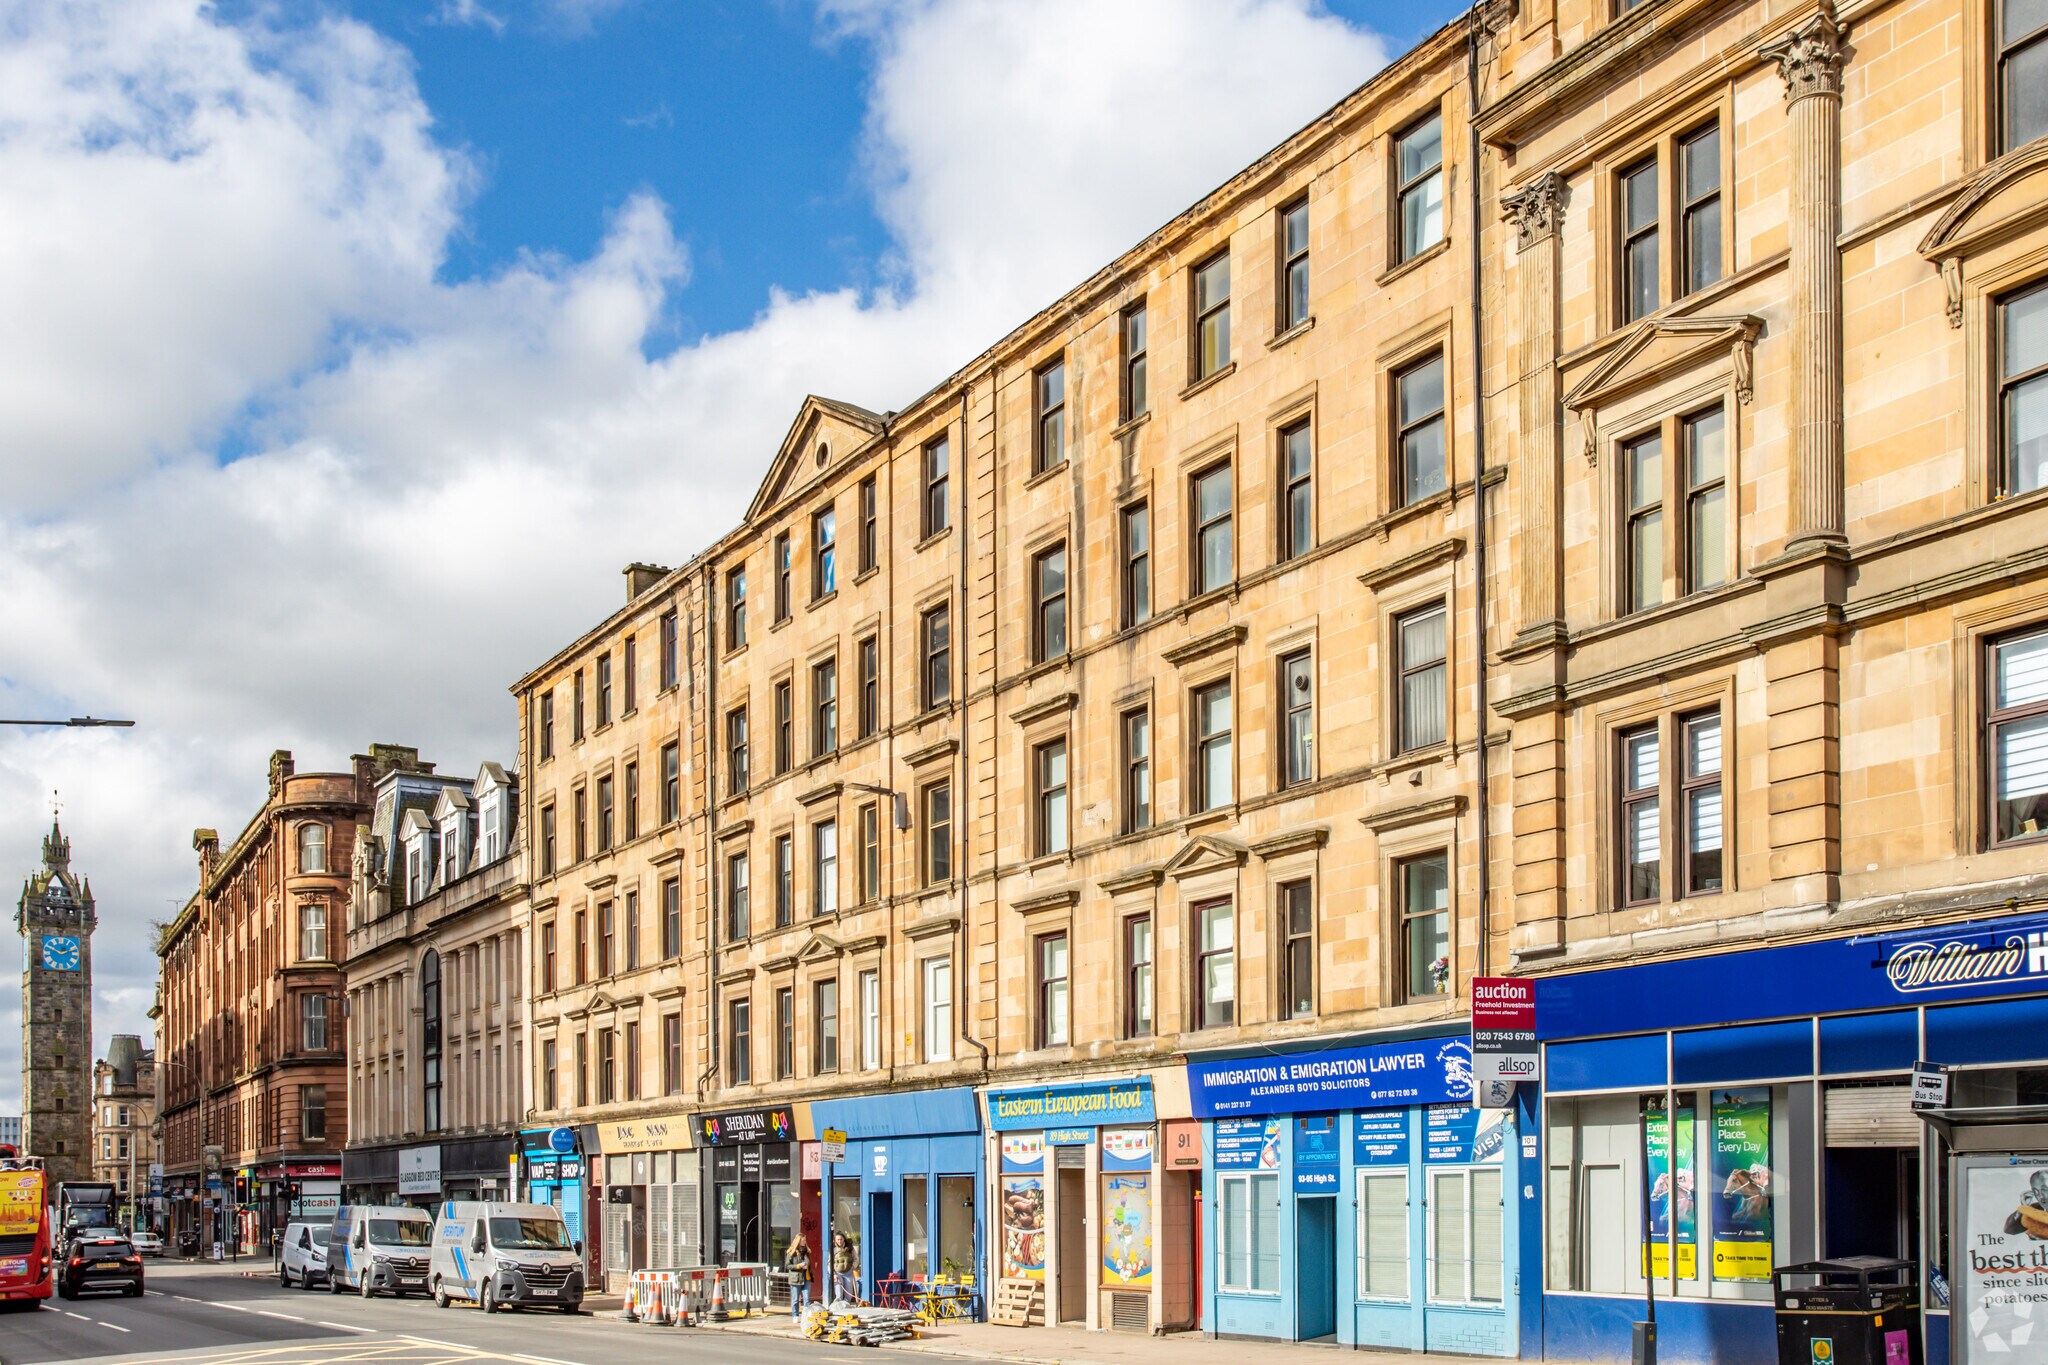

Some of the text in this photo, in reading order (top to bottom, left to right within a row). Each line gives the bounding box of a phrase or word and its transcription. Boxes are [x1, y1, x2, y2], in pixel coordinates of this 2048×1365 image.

[1887, 935, 2025, 988] William
[1475, 982, 1527, 999] auction
[1475, 1032, 1535, 1041] 020 7543 6780
[1203, 1053, 1425, 1087] IMMIGRATION & EMIGRATION LAWYER
[1498, 1057, 1535, 1075] allsop
[1250, 1078, 1370, 1096] ALEXANDER BOYD SOLICITORS
[1396, 1089, 1403, 1097] 72
[999, 1085, 1142, 1117] Eastern European Food
[1915, 1091, 1943, 1101] Bus Stop
[725, 1113, 765, 1131] SHERIDAN
[1646, 1123, 1668, 1132] Extra
[1718, 1117, 1742, 1127] Extra
[738, 1131, 745, 1140] AT
[1050, 1129, 1089, 1143] 89 High Street
[1178, 1133, 1191, 1148] 91
[1646, 1135, 1668, 1145] Place
[1718, 1129, 1746, 1140] Places
[1473, 1132, 1503, 1156] VISA
[1718, 1141, 1761, 1154] Every Day
[1646, 1147, 1687, 1159] Every ay
[400, 1170, 440, 1183] GLASGOW BED CENTRE
[561, 1163, 578, 1178] SHOP
[1298, 1173, 1337, 1184] 93-95 High St.
[1977, 1233, 2005, 1246] The
[1969, 1249, 2026, 1271] best
[1983, 1276, 2021, 1289] since
[1984, 1292, 2048, 1309] potatoes
